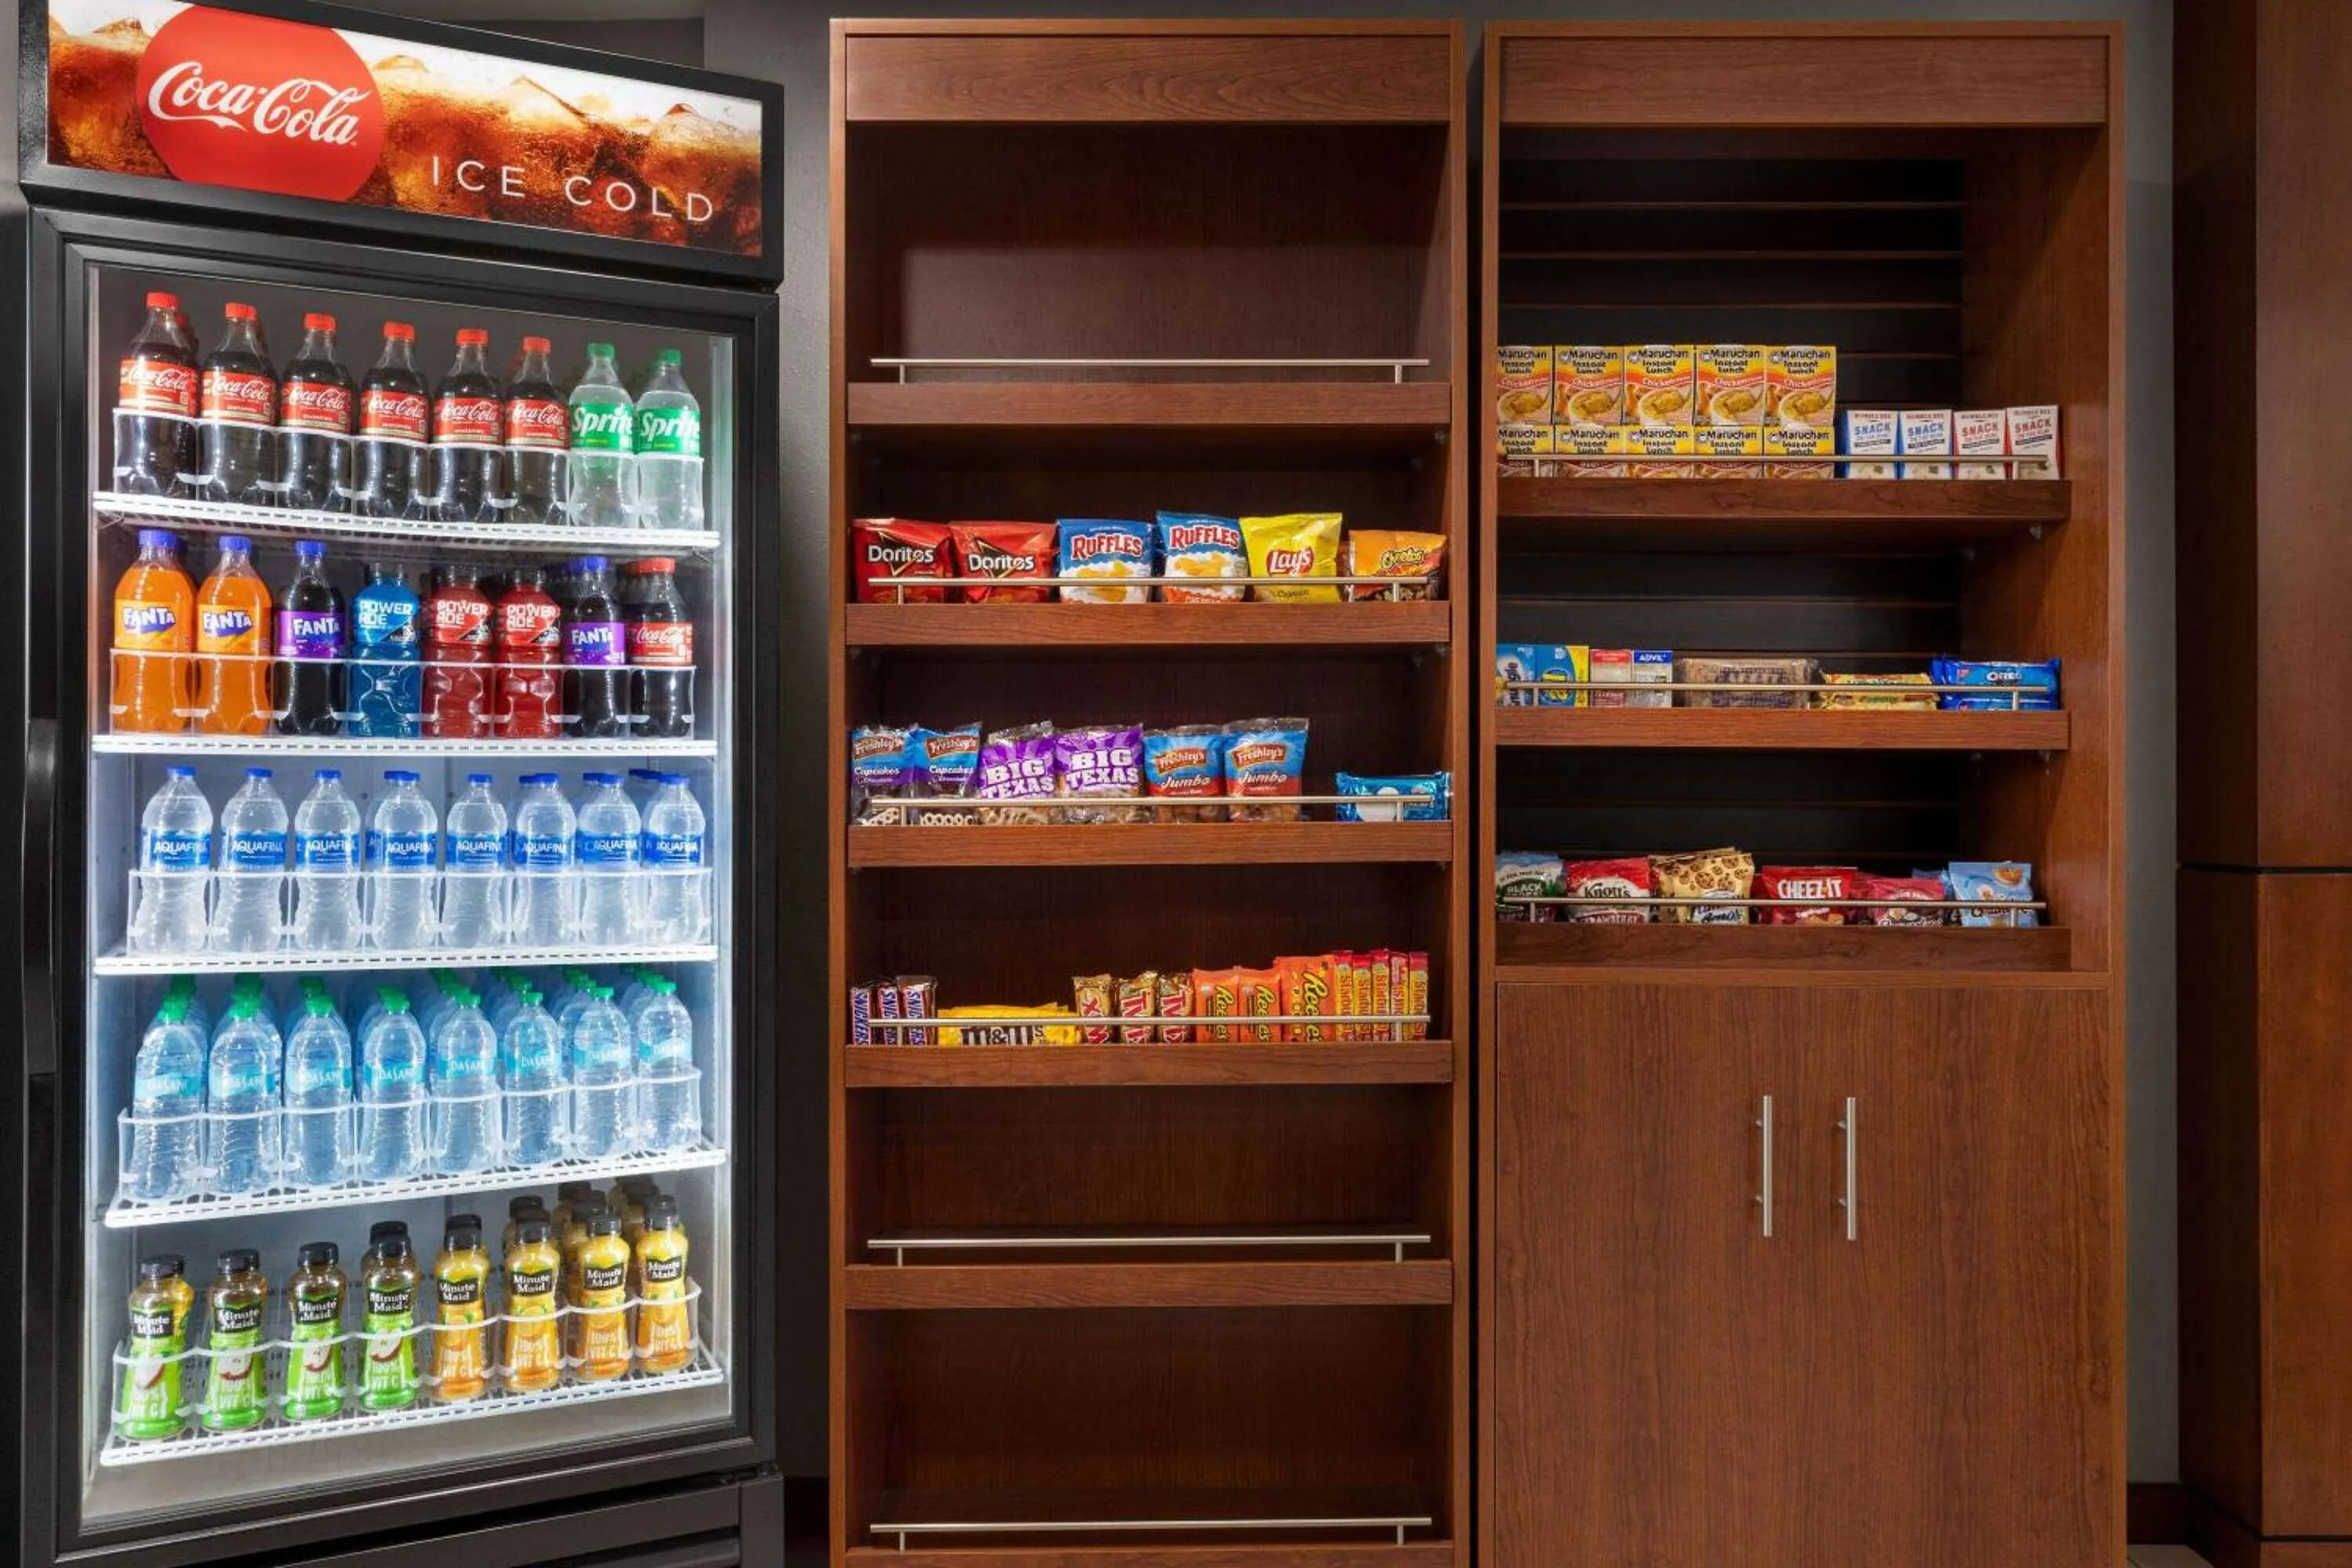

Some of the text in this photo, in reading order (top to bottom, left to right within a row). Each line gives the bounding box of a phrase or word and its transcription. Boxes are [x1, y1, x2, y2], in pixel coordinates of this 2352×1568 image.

[148, 61, 372, 147] Coca-Cola
[432, 155, 714, 223] ICE COLD
[1498, 350, 1547, 359] Maruchan
[1570, 350, 1617, 359] Maruchan
[1639, 349, 1688, 358] Maruchan
[1710, 350, 1760, 358] Maruchan
[1780, 350, 1831, 359] Maruchan
[1854, 423, 1891, 435] SNACK
[1907, 422, 1945, 436] SNACK
[1962, 423, 1998, 437] SNACK
[2015, 418, 2052, 434] SNACK
[1498, 430, 1548, 438] Maruchan
[1570, 430, 1619, 439] Maruchan
[1639, 430, 1688, 438] Maruchan
[1707, 430, 1757, 439] Maruchan
[1779, 430, 1829, 439] Maruchan
[1170, 524, 1239, 549] RUFFLES
[1071, 533, 1142, 560] RUFFLES
[868, 546, 935, 563] Doritos
[1270, 547, 1313, 575] Lay's
[968, 554, 1036, 571] Doritos
[360, 599, 412, 615] POWER
[436, 600, 488, 615] POWER
[506, 603, 556, 618] POWER
[123, 606, 176, 626] FANTA
[203, 611, 252, 630] FANTA
[359, 612, 388, 626] ADE
[436, 613, 465, 626] ADE
[506, 616, 536, 628] ADE
[1071, 748, 1134, 769] BIG
[854, 766, 901, 776] Cupcakes
[928, 765, 975, 775] Cupcakes
[985, 759, 1046, 783] BIG
[1065, 767, 1140, 789] TEXAS
[1161, 774, 1211, 789] Jumbo
[1239, 772, 1287, 784] Jumbo
[982, 776, 1055, 800] TEXAS
[1507, 884, 1544, 892] BLACK
[1584, 883, 1632, 898] Knott's
[1777, 878, 1843, 899] CHEEZ-IT
[1216, 985, 1236, 1040] Reee's
[1254, 985, 1276, 1041] Reee's
[648, 1259, 681, 1271] Minute
[513, 1272, 550, 1285] Minute
[588, 1267, 622, 1279] Minute
[651, 1268, 678, 1279] Maid
[440, 1282, 476, 1294] Minute
[516, 1282, 546, 1293] Maid
[592, 1276, 619, 1287] Maid
[369, 1290, 411, 1304] Minute
[442, 1291, 470, 1302] Maid
[298, 1300, 337, 1312] Minute
[372, 1299, 401, 1312] Maid
[217, 1308, 260, 1323] Minute
[300, 1309, 331, 1323] Maid
[220, 1318, 255, 1333] Maid
